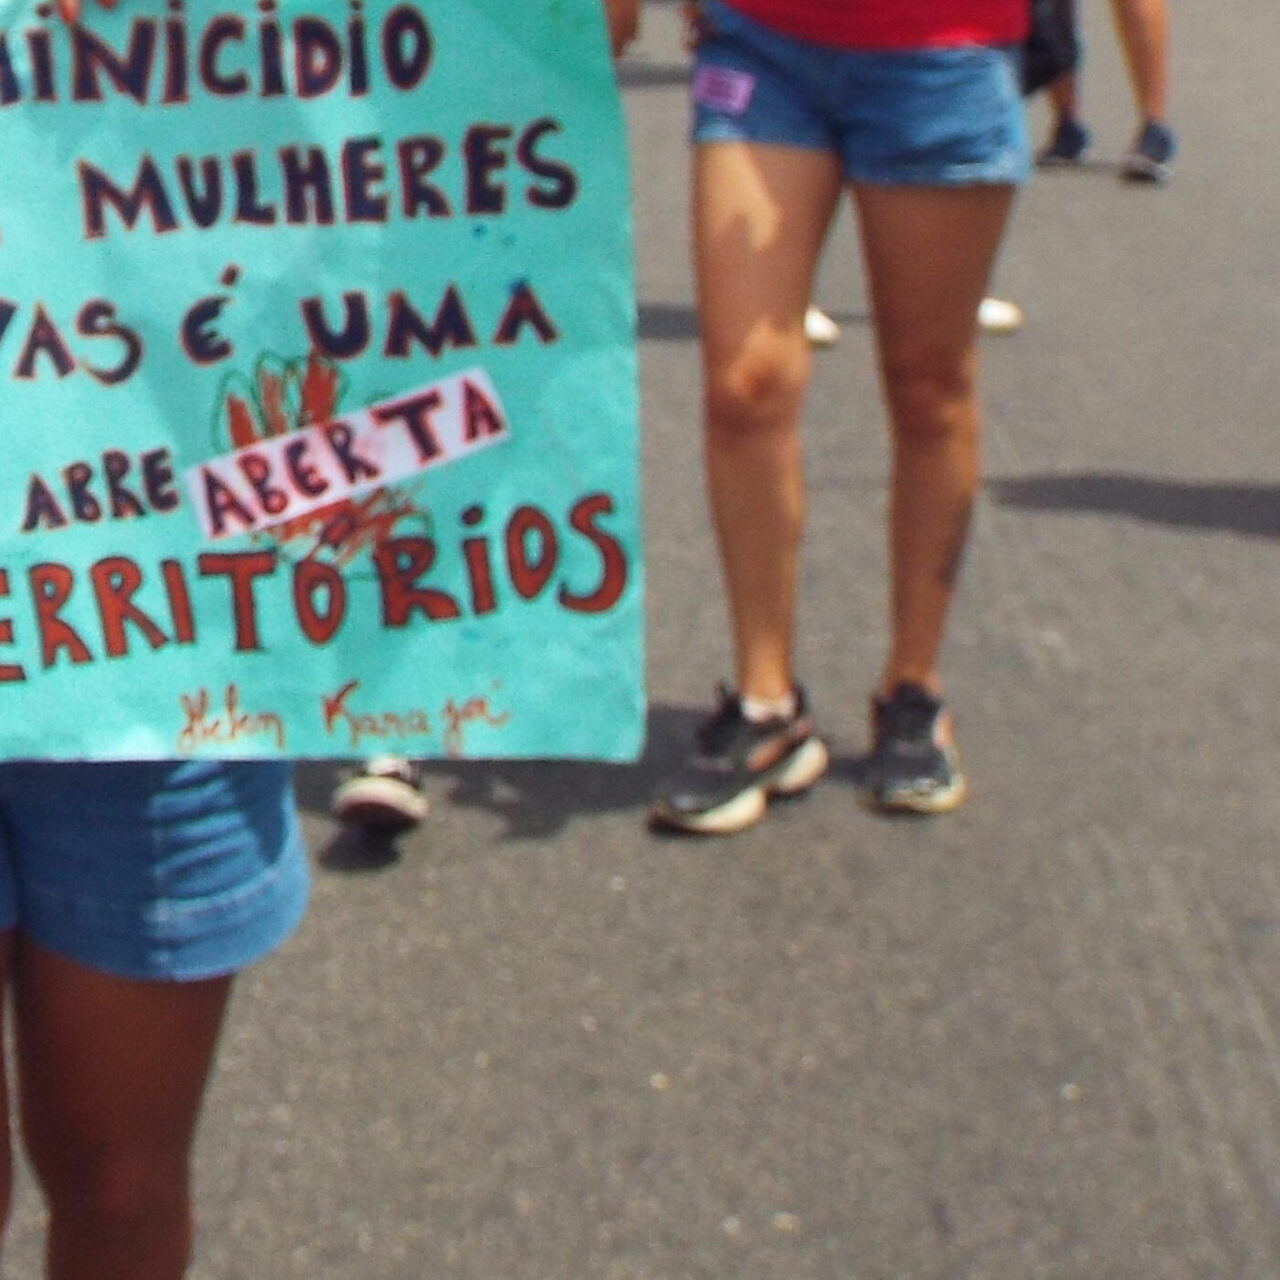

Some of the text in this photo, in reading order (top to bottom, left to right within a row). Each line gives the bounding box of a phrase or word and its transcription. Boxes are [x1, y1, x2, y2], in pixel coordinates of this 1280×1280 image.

[77, 115, 580, 240] MULHERES
[179, 263, 242, 368] É
[300, 278, 561, 364] UMA
[20, 447, 182, 533] ABRE
[198, 375, 505, 539] ABERTA
